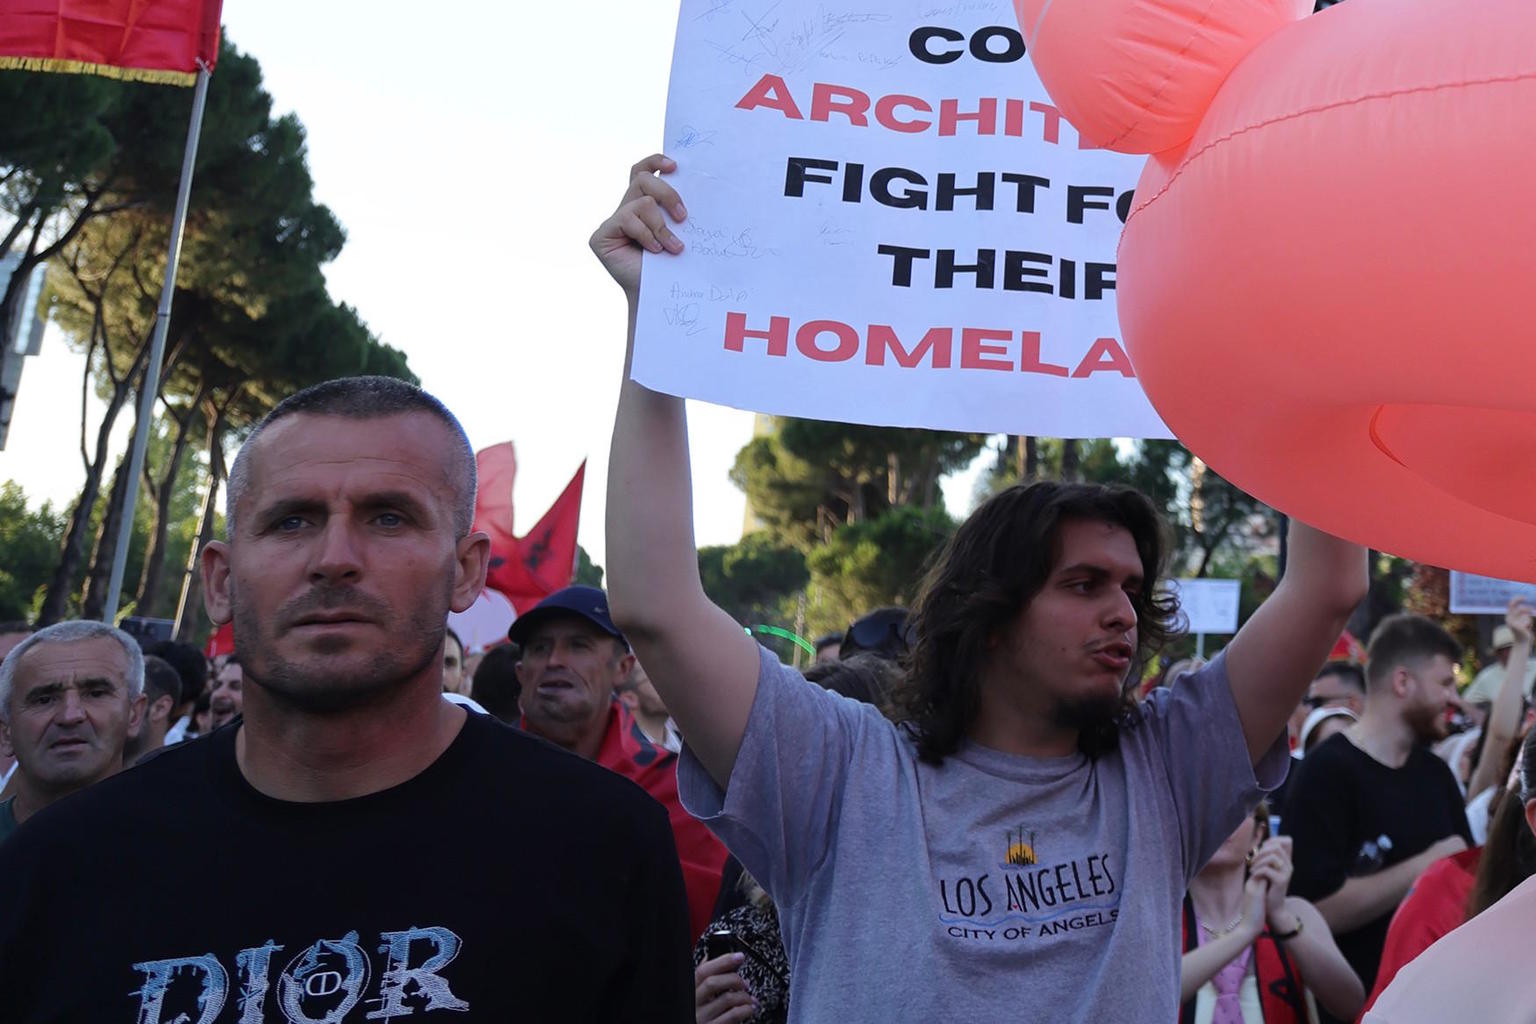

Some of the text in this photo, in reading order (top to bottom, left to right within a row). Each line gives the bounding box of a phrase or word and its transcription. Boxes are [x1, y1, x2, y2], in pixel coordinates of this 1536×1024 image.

[784, 157, 1050, 214] FIGHT
[940, 854, 1116, 917] LOS ANGELES
[948, 909, 1120, 940] CITY OF ANGELS
[130, 927, 470, 1024] DIOR
